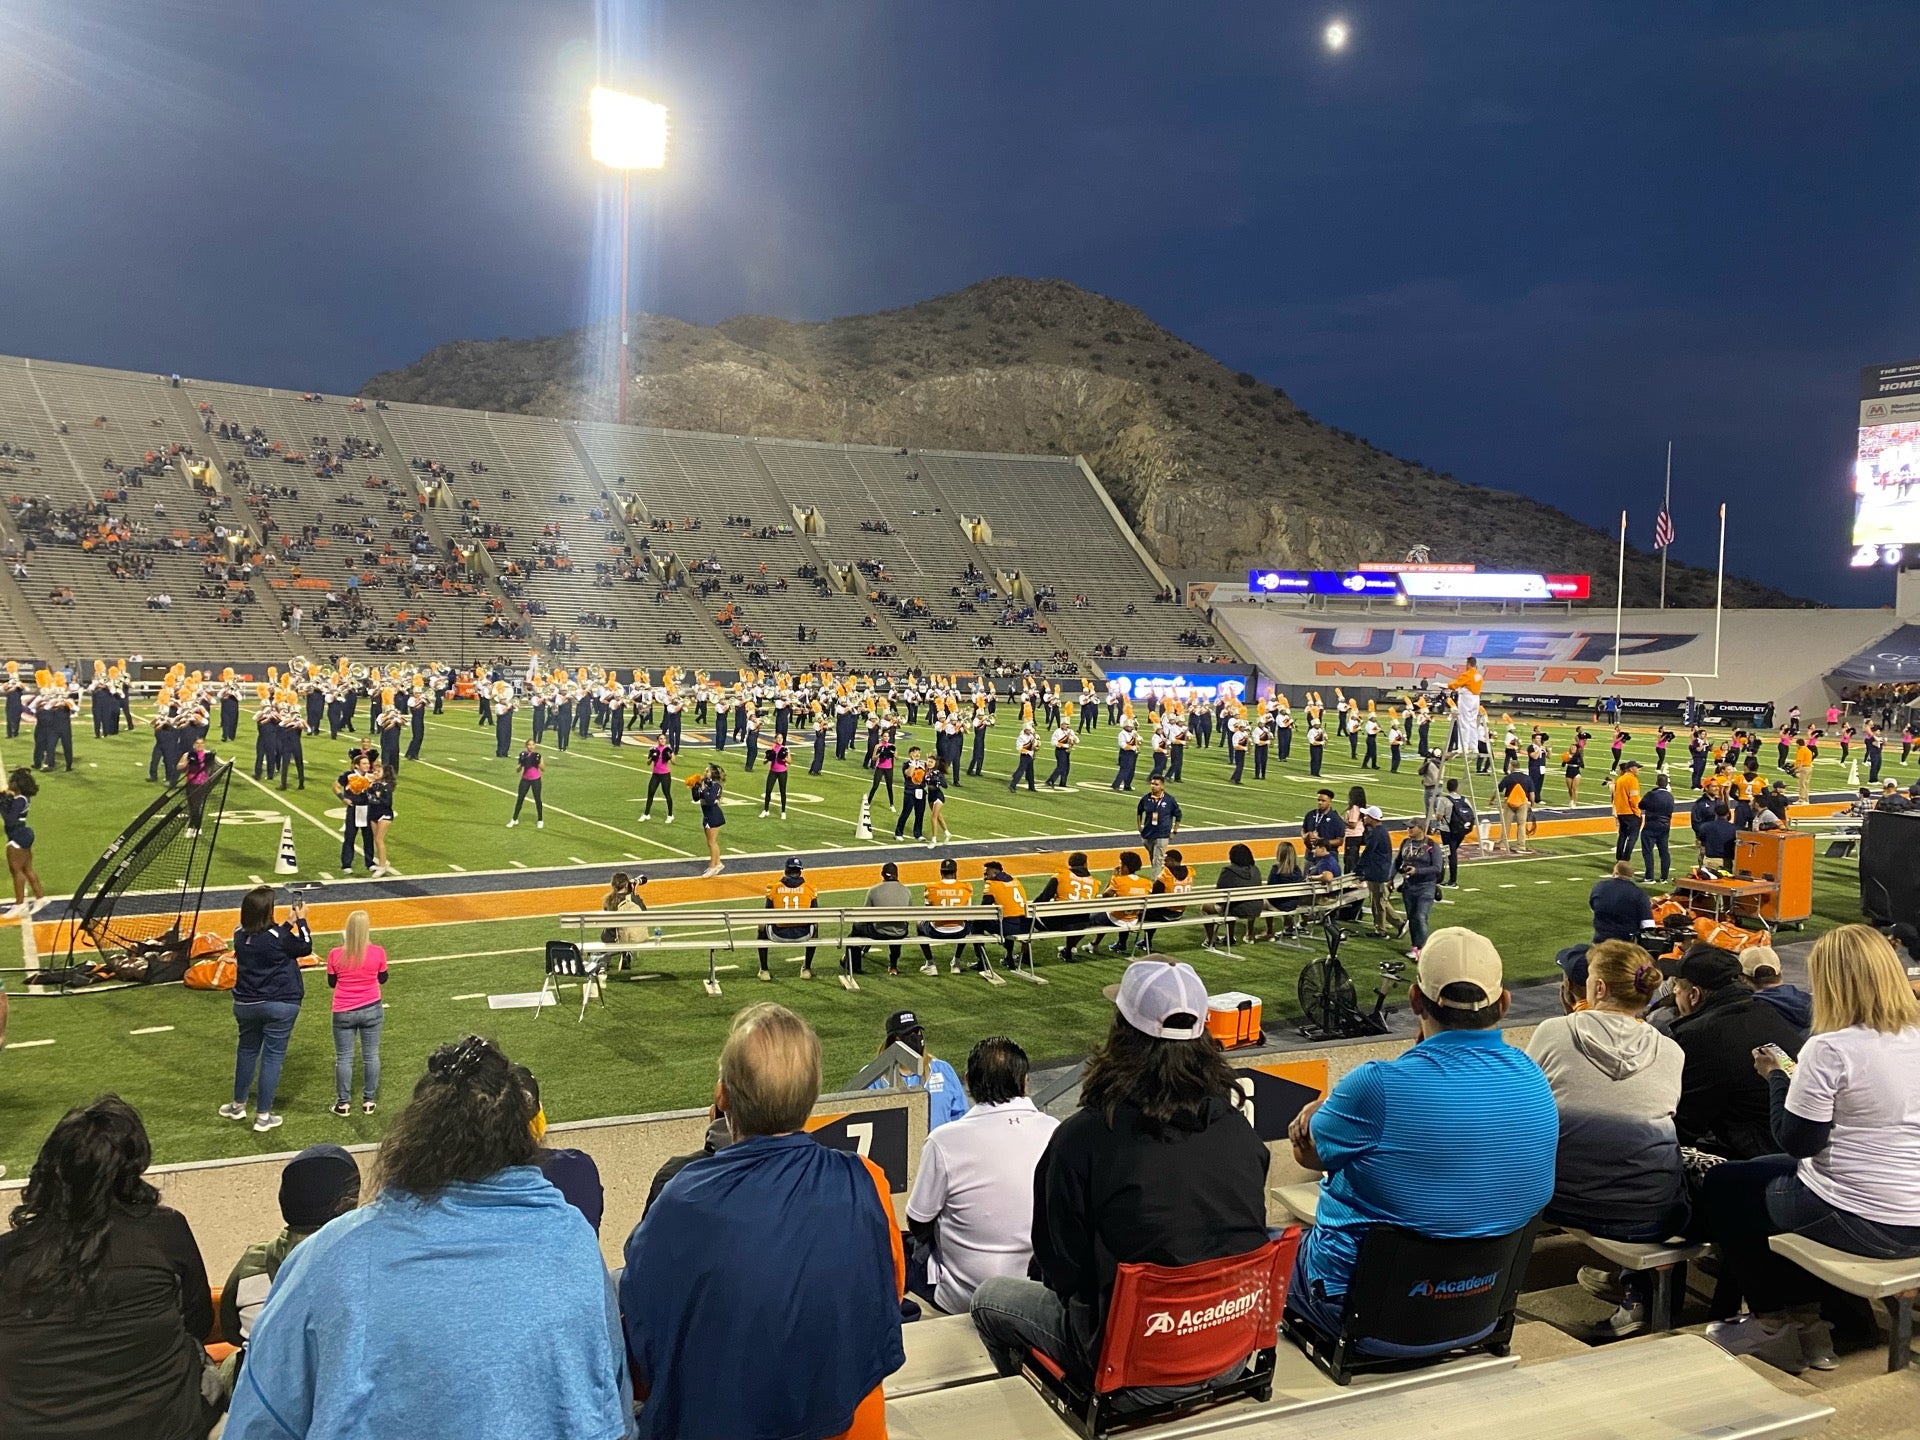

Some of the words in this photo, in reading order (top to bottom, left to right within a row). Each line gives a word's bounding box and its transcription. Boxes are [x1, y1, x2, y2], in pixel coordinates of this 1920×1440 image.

[1299, 626, 1701, 662] UTEP
[1316, 660, 1671, 685] MINERS
[1517, 696, 1560, 704] CHEVROLET
[783, 895, 799, 910] 11
[1013, 887, 1025, 907] 4
[1068, 880, 1093, 900] 33
[846, 1122, 874, 1159] 7
[1434, 1268, 1503, 1293] Academy
[1177, 1288, 1264, 1329] Academy
